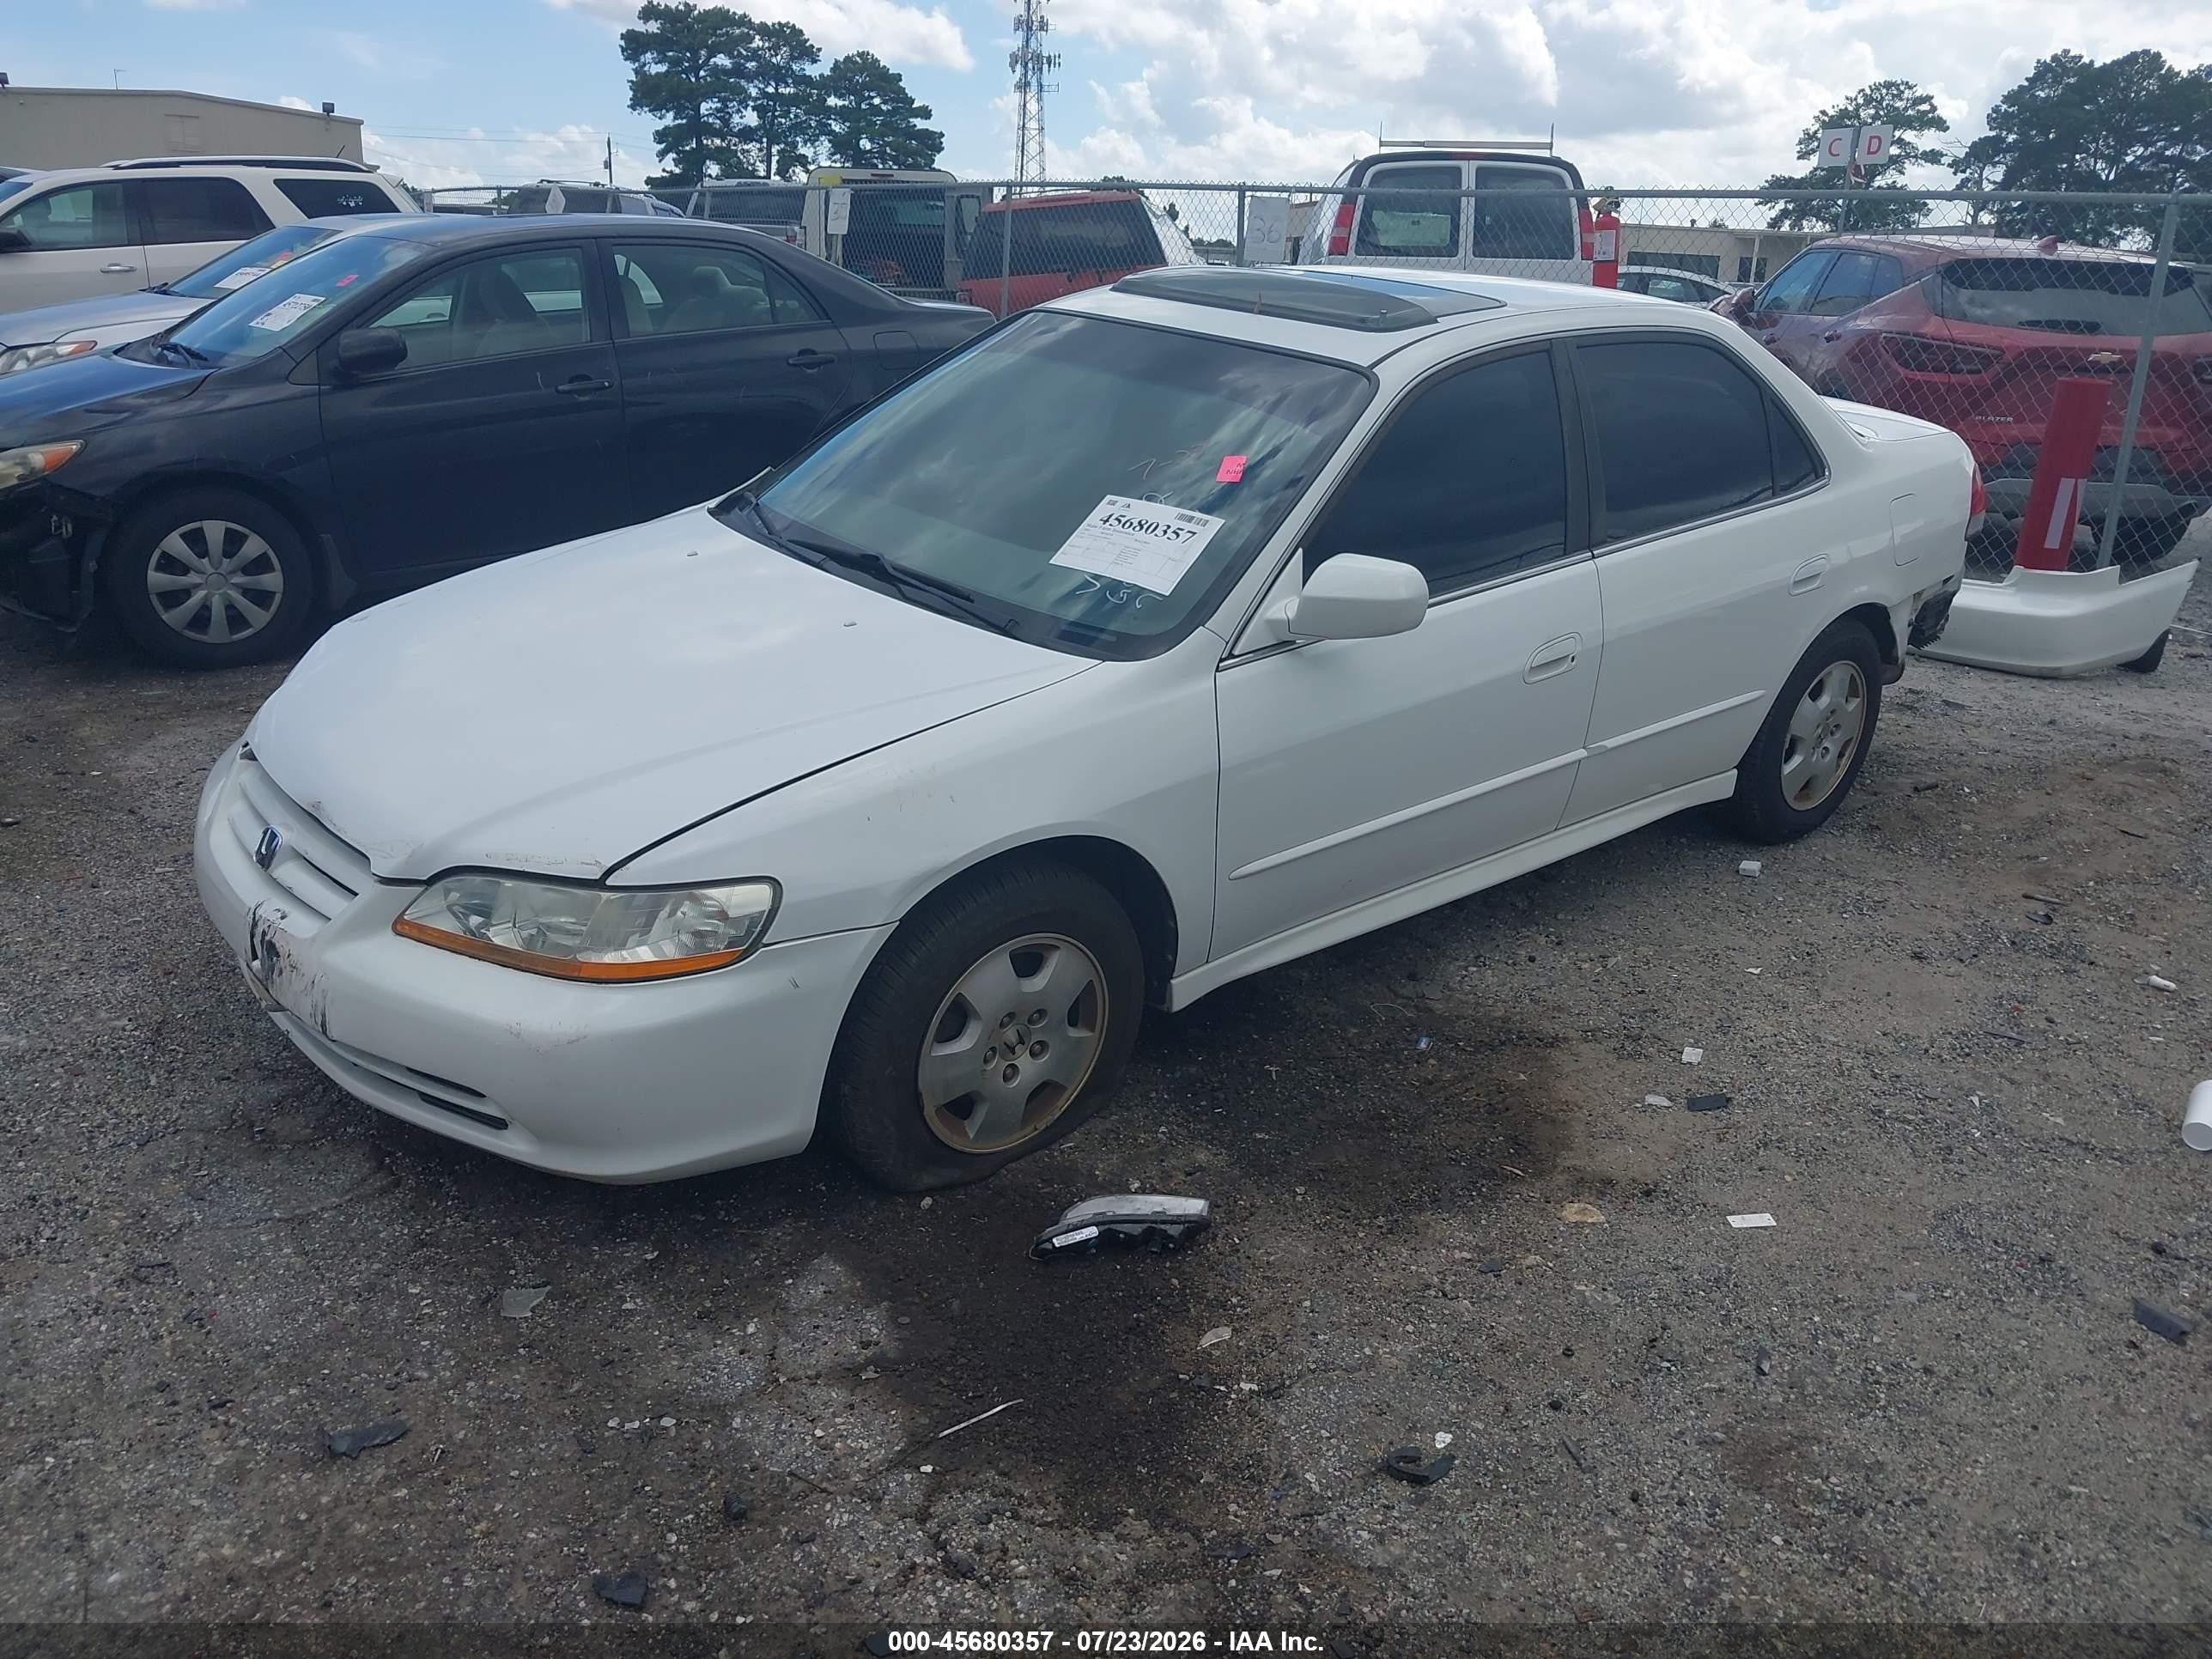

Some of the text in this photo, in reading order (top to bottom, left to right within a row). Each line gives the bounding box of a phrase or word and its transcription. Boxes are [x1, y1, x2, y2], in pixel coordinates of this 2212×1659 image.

[1827, 137, 1843, 157] C
[1866, 135, 1883, 155] D
[1252, 215, 1282, 244] 36
[1099, 512, 1198, 544] 45680357
